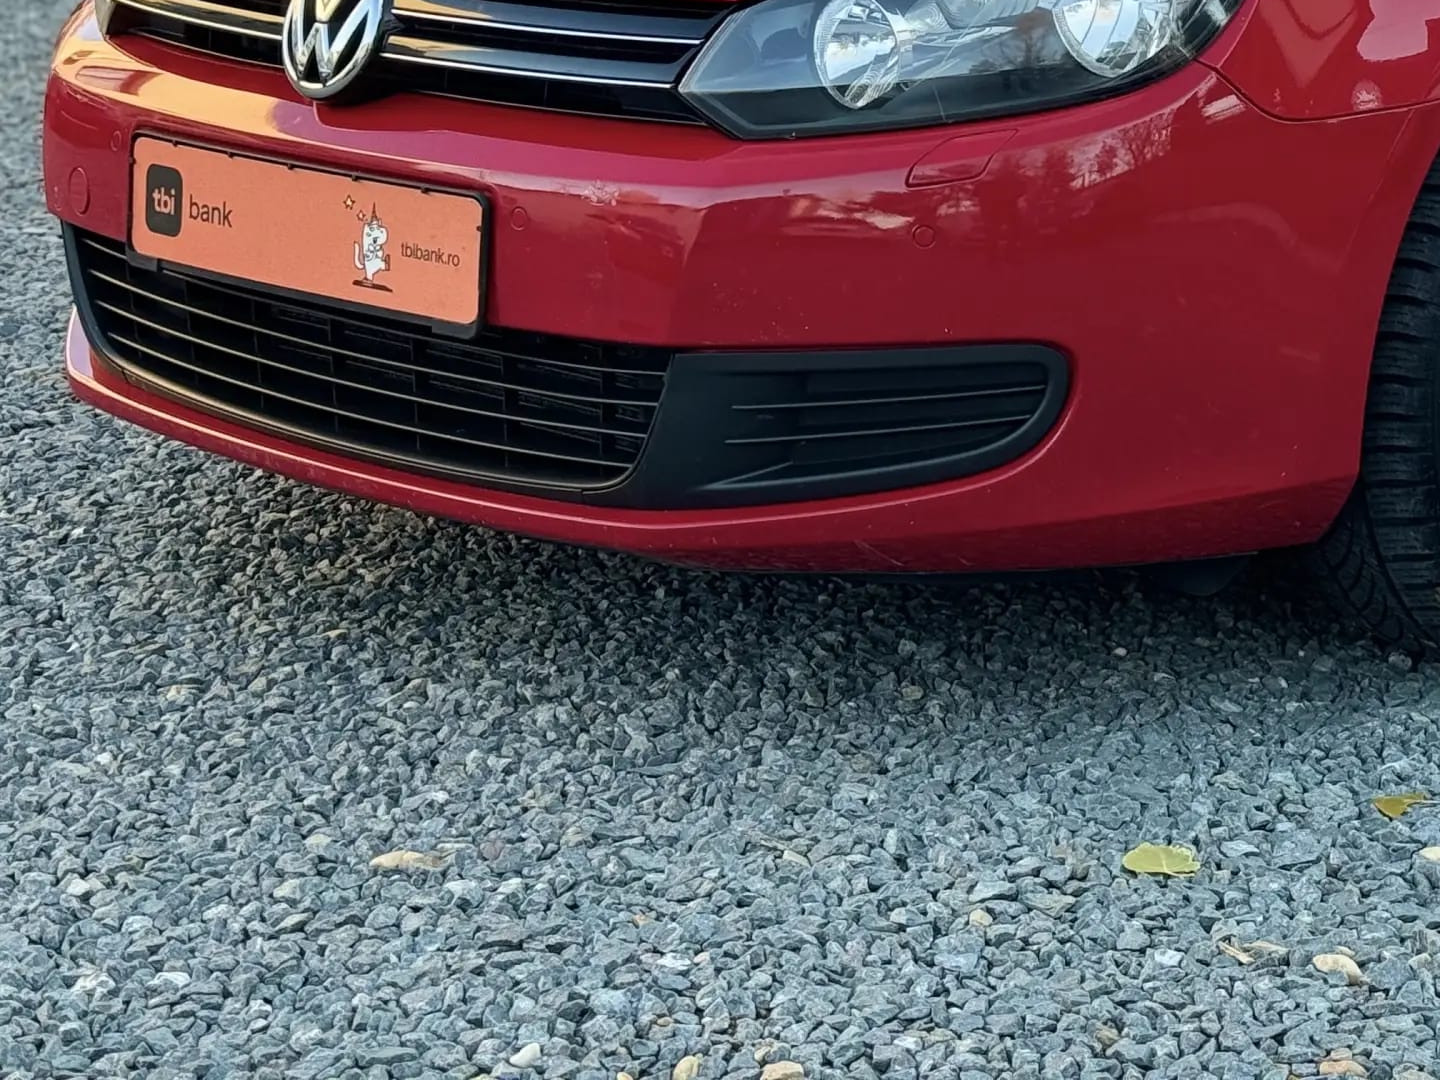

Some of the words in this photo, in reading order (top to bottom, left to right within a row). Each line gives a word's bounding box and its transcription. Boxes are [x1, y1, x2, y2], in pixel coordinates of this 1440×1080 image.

[152, 186, 176, 216] tbi
[189, 193, 233, 228] bank
[401, 241, 461, 268] tbibank.ro
